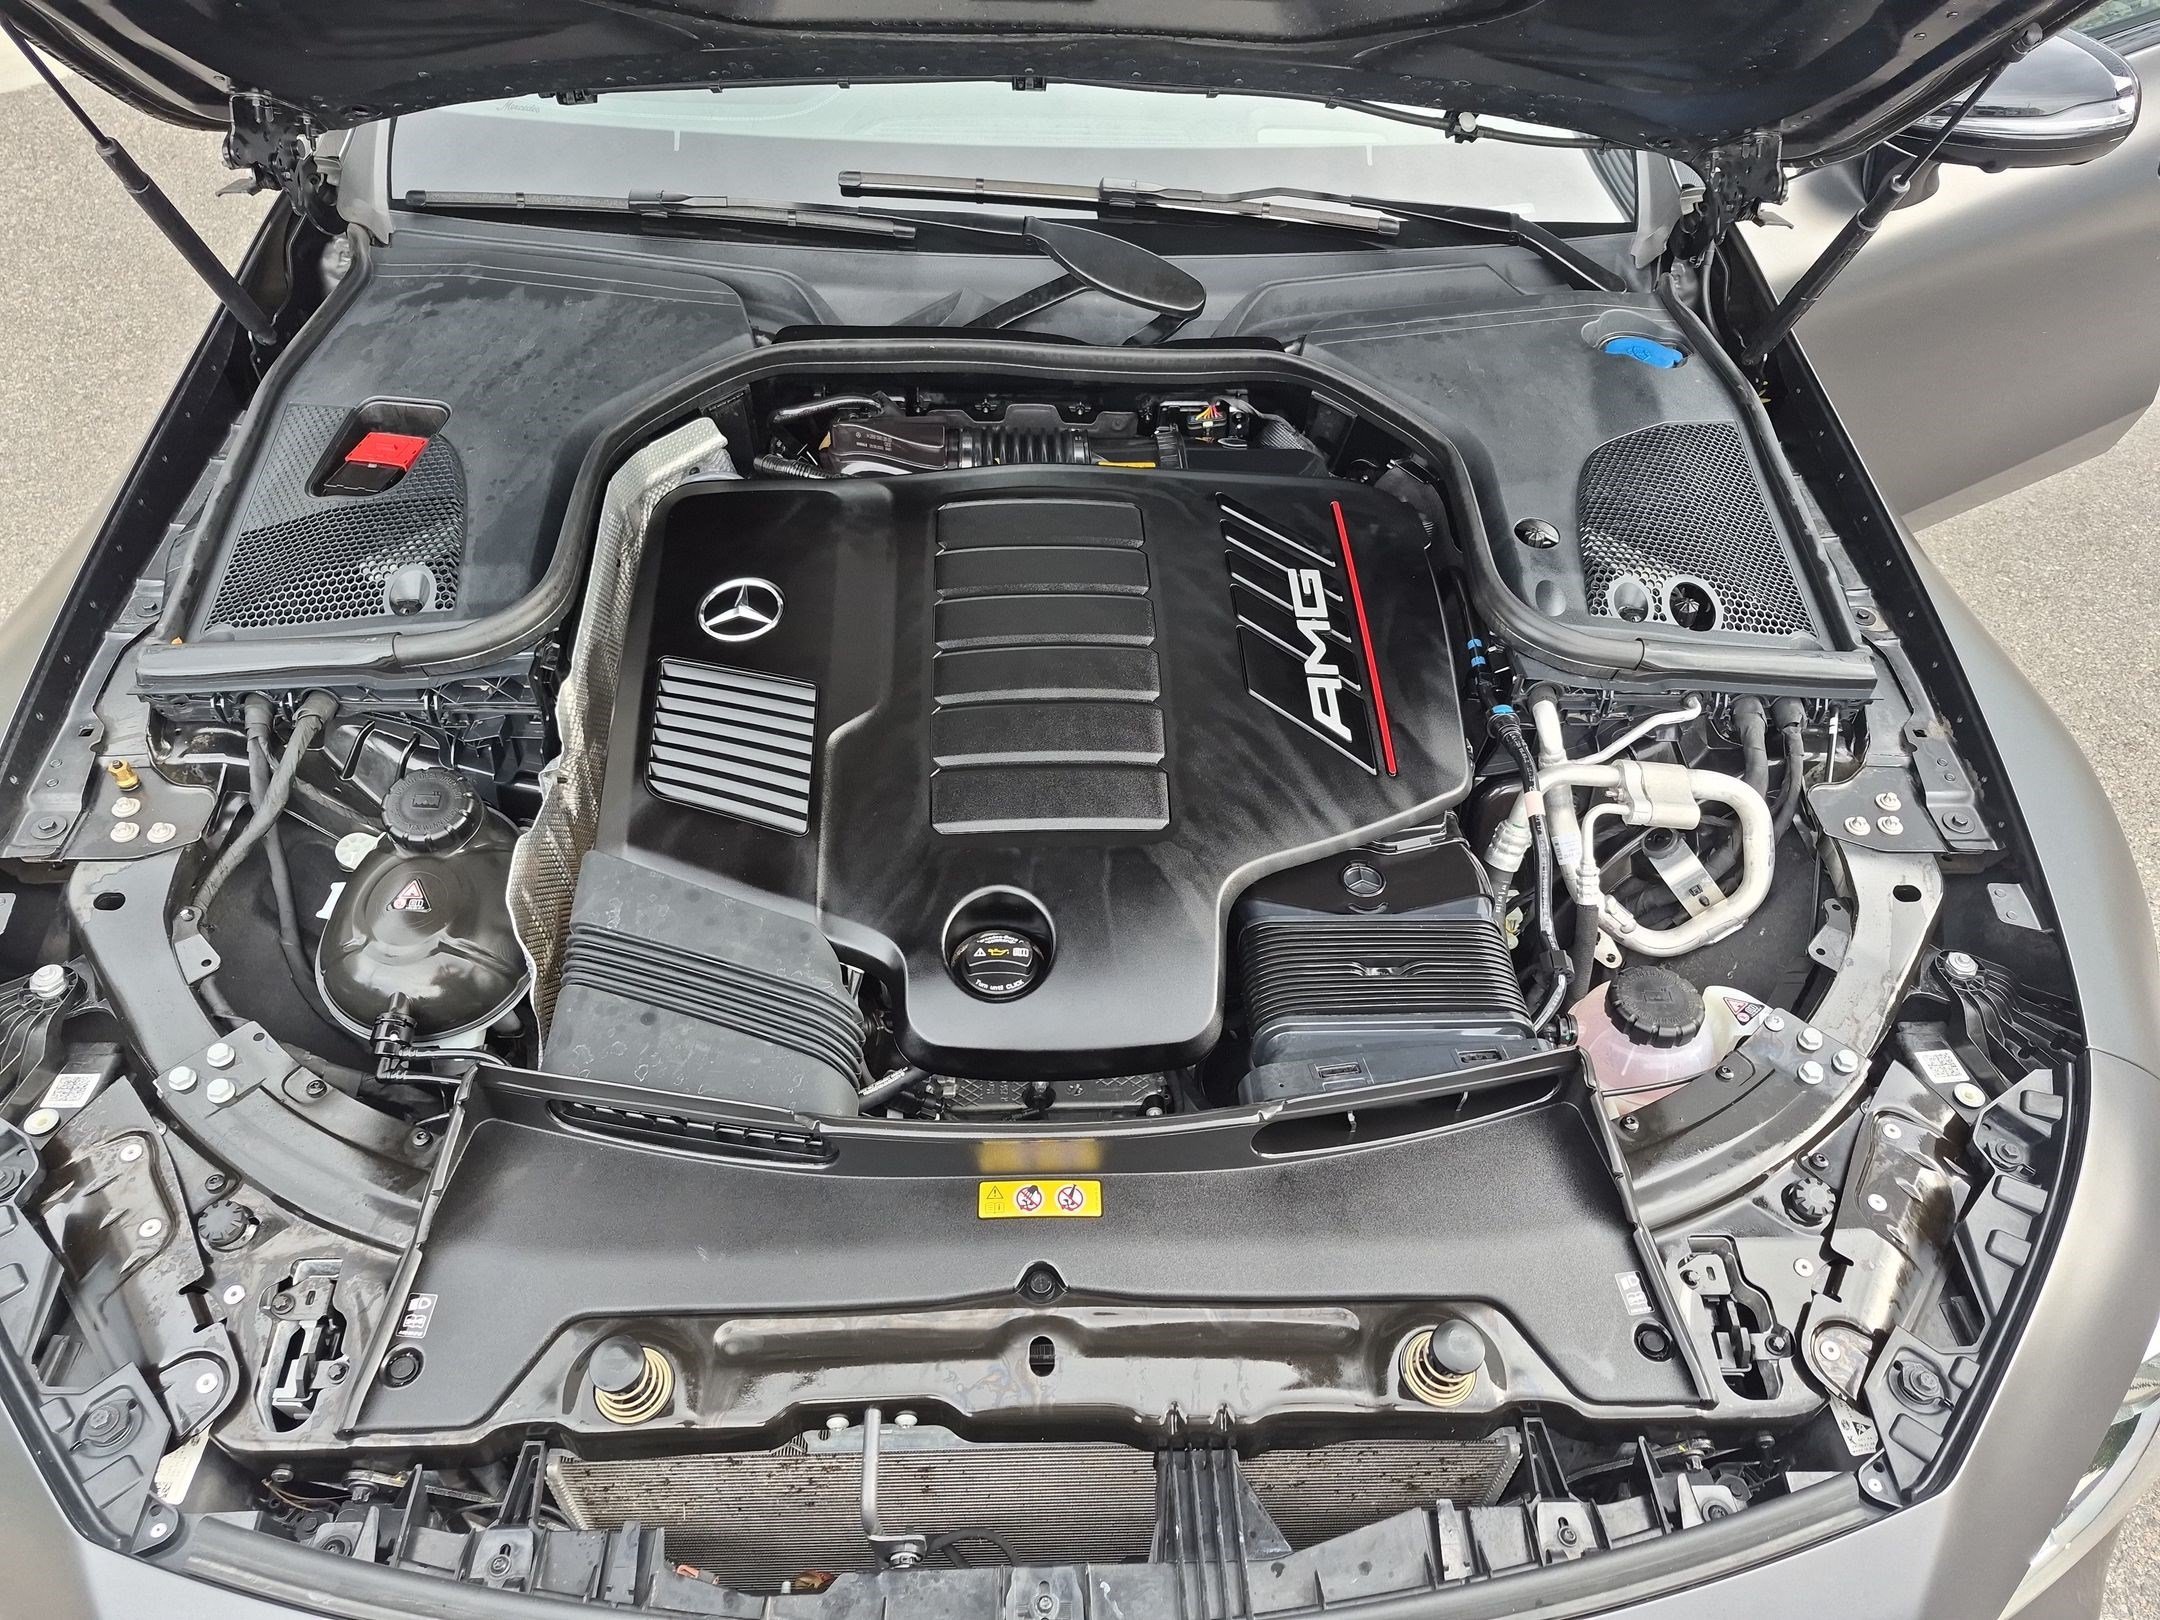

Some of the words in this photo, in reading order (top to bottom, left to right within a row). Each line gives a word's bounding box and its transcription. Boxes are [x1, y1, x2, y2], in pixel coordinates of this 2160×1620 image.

[1287, 568, 1352, 743] AMG
[975, 978, 989, 989] Turn
[1005, 978, 1025, 990] CLICK
